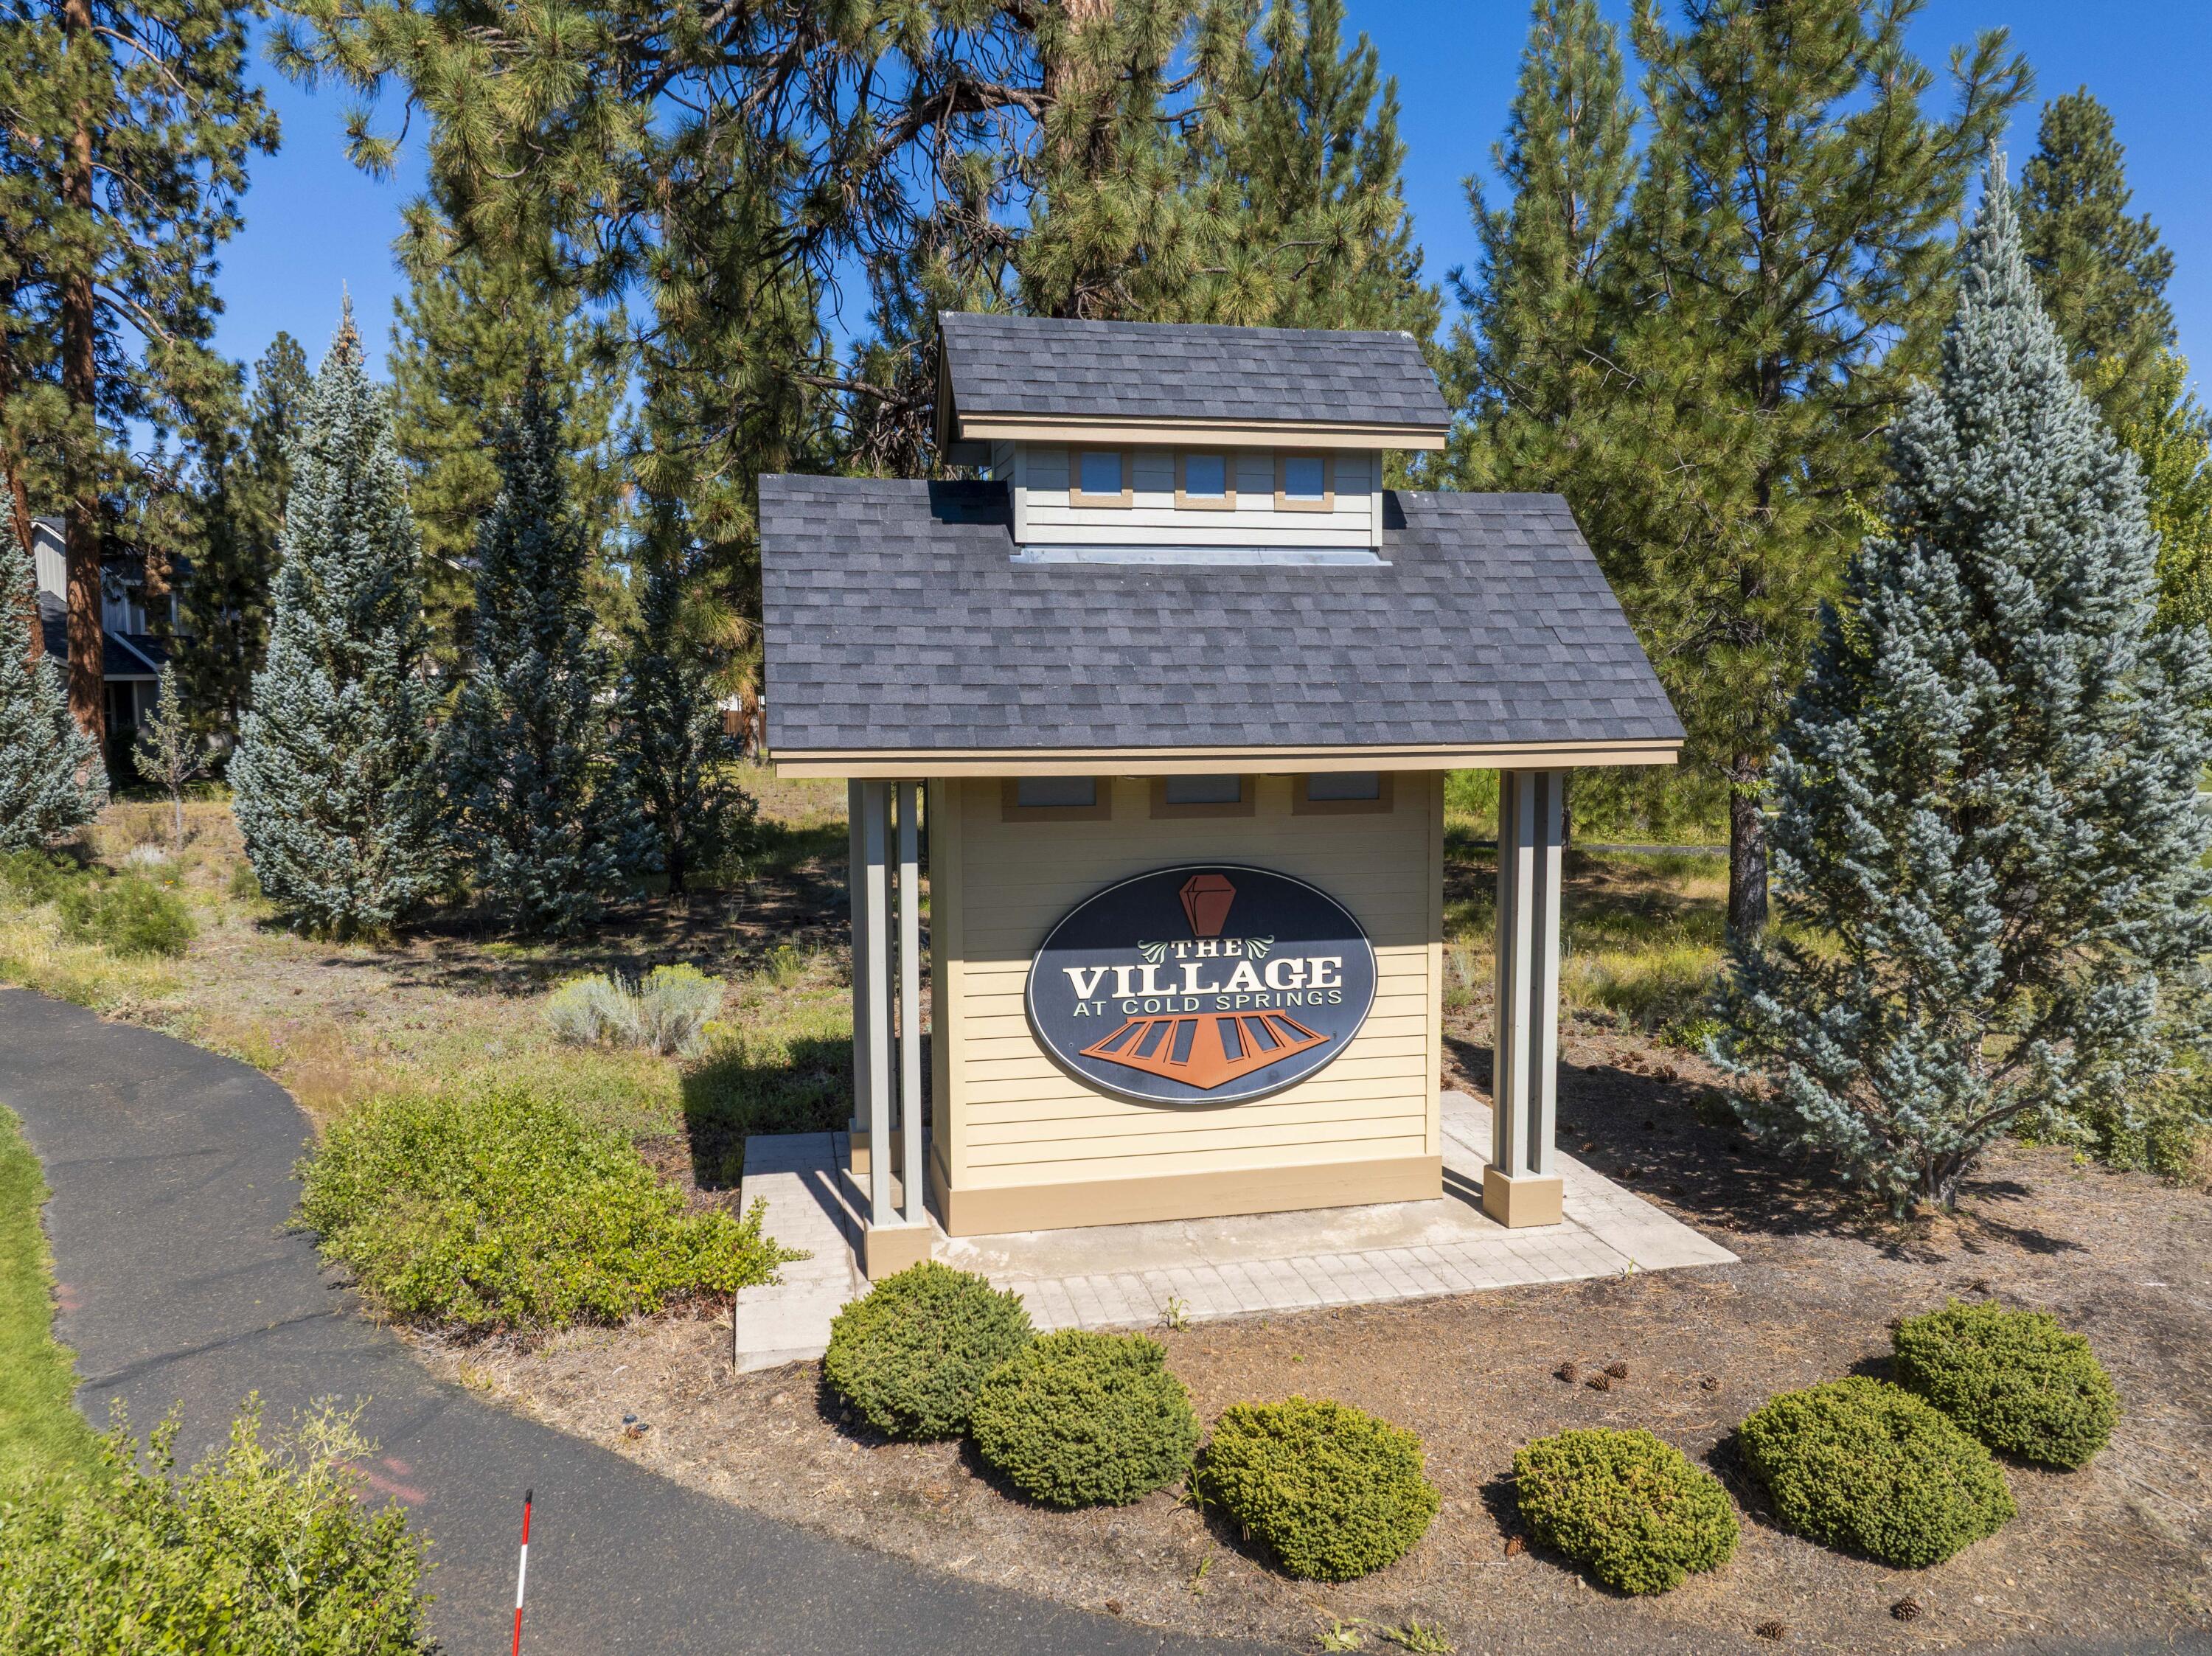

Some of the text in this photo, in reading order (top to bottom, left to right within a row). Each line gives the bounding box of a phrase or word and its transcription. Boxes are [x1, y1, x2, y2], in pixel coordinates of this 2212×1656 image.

[1171, 938, 1242, 959] THE
[1062, 956, 1342, 1000] VILLAGE
[1073, 990, 1343, 1017] AT COLD SPRINGS
